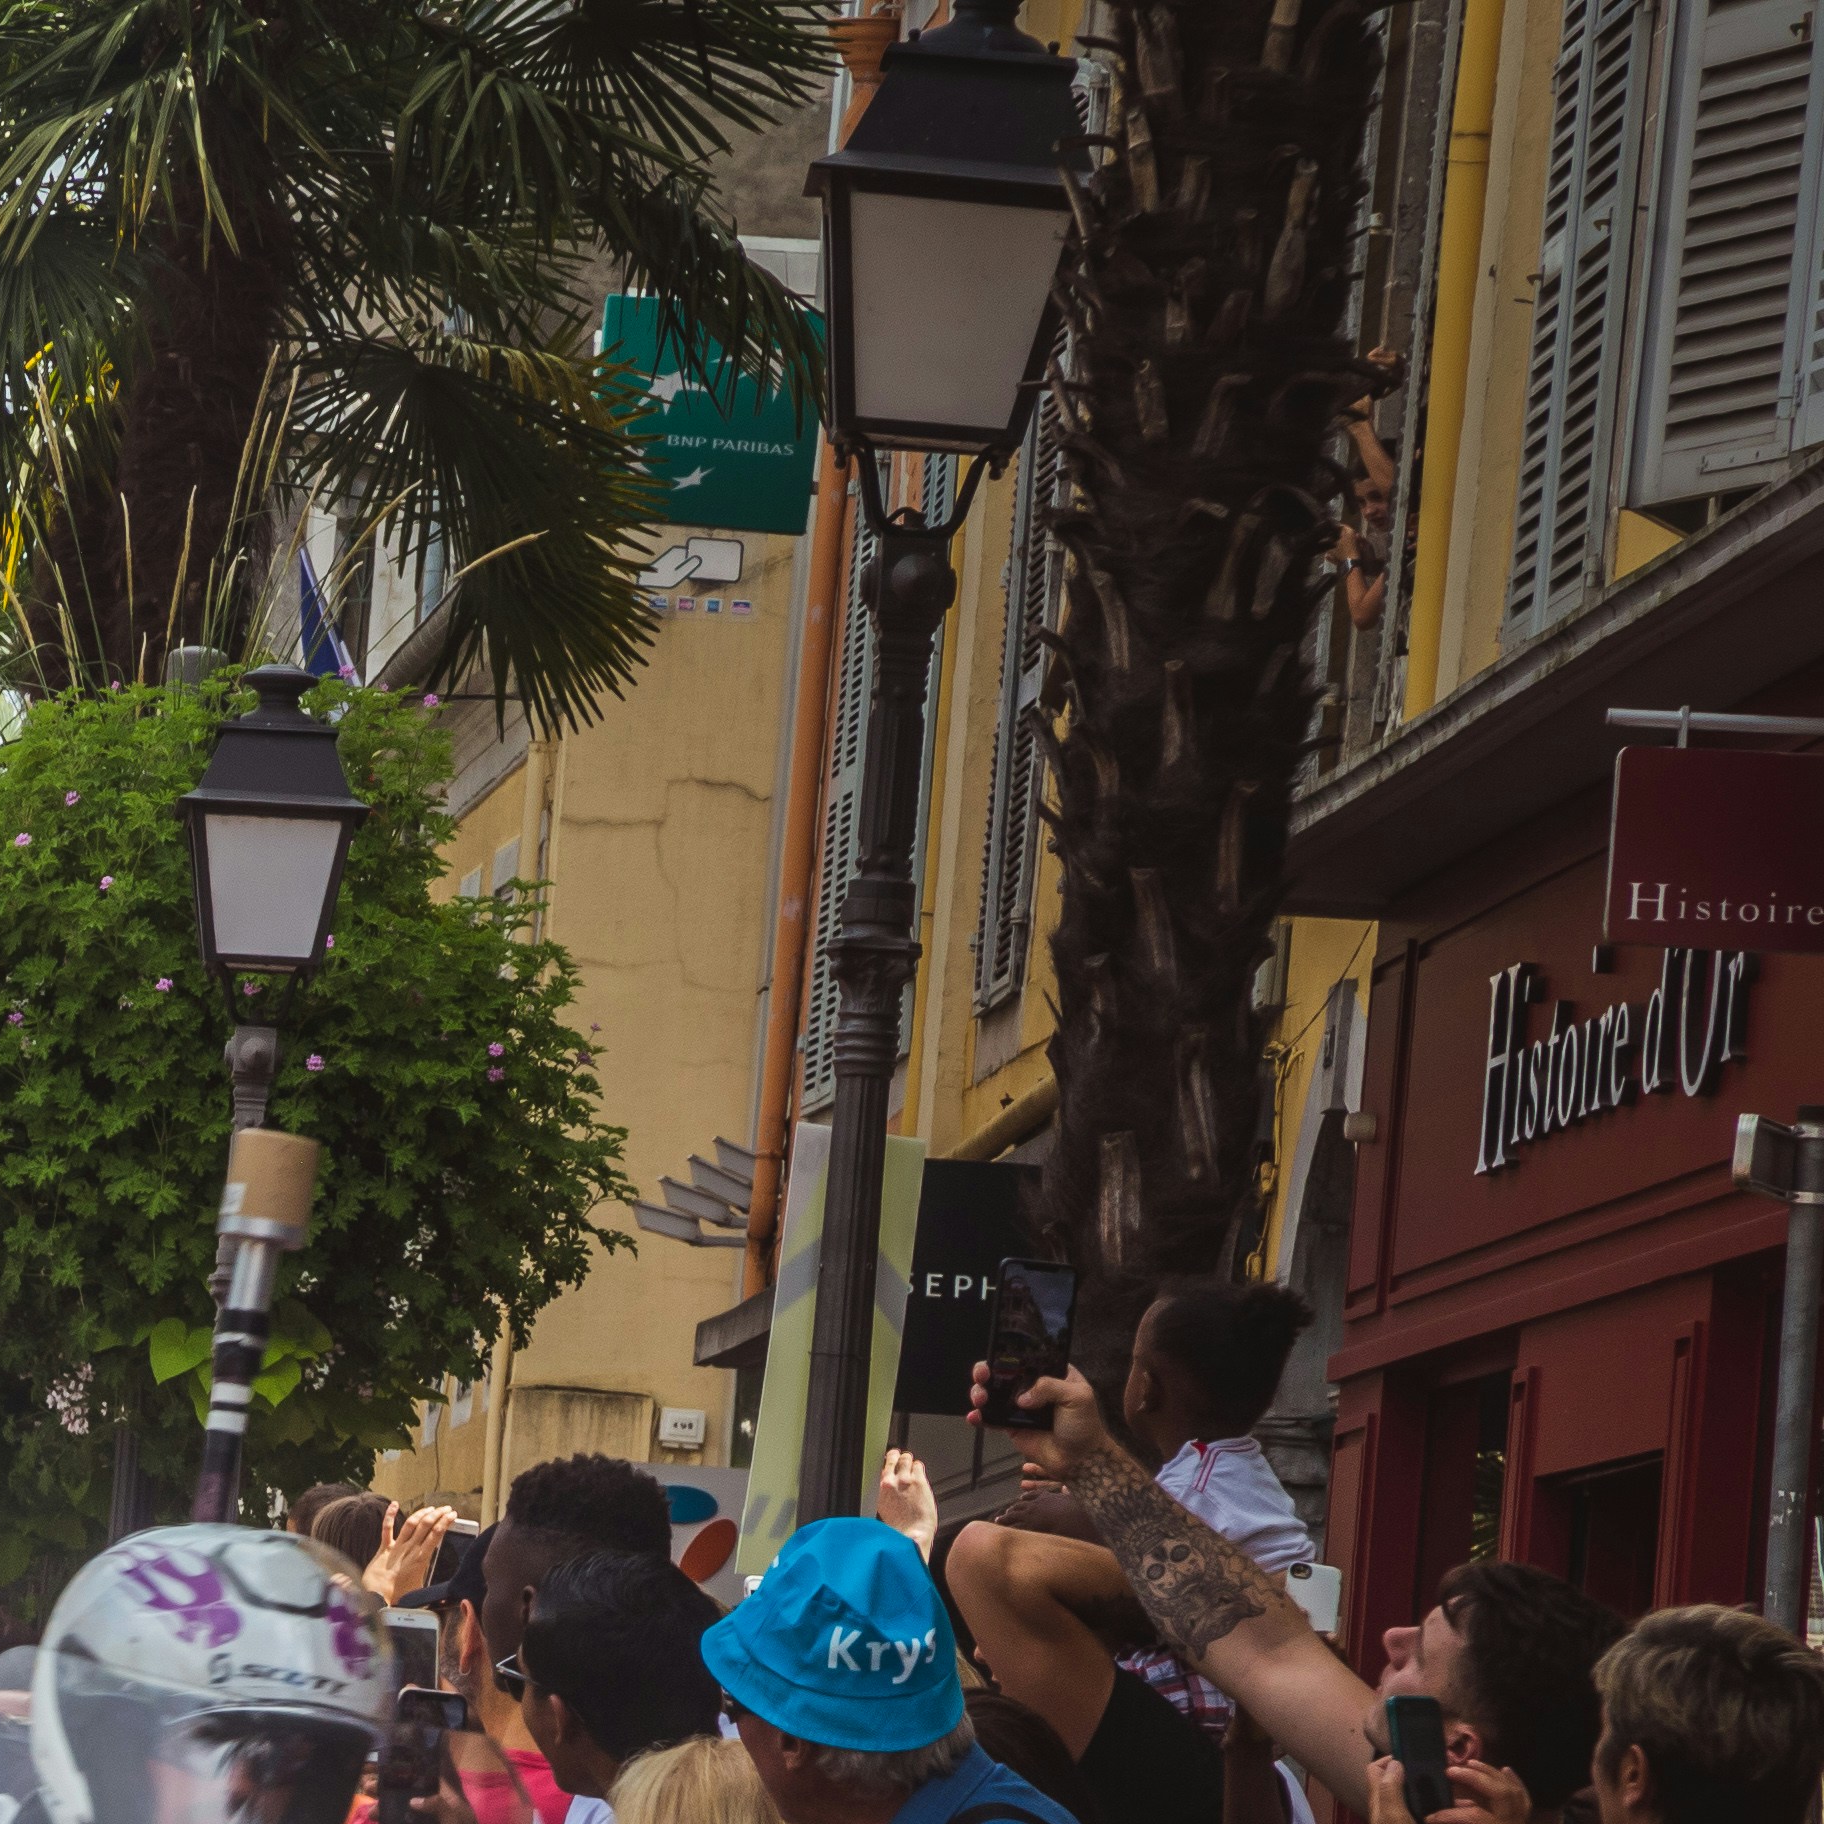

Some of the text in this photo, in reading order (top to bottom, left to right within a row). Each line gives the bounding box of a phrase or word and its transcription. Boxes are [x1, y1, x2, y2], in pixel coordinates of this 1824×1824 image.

[667, 433, 795, 457] BNP PARIBAS
[1625, 881, 1824, 928] Histoire
[1474, 962, 1630, 1176] Histoire
[827, 1625, 937, 1685] Krys
